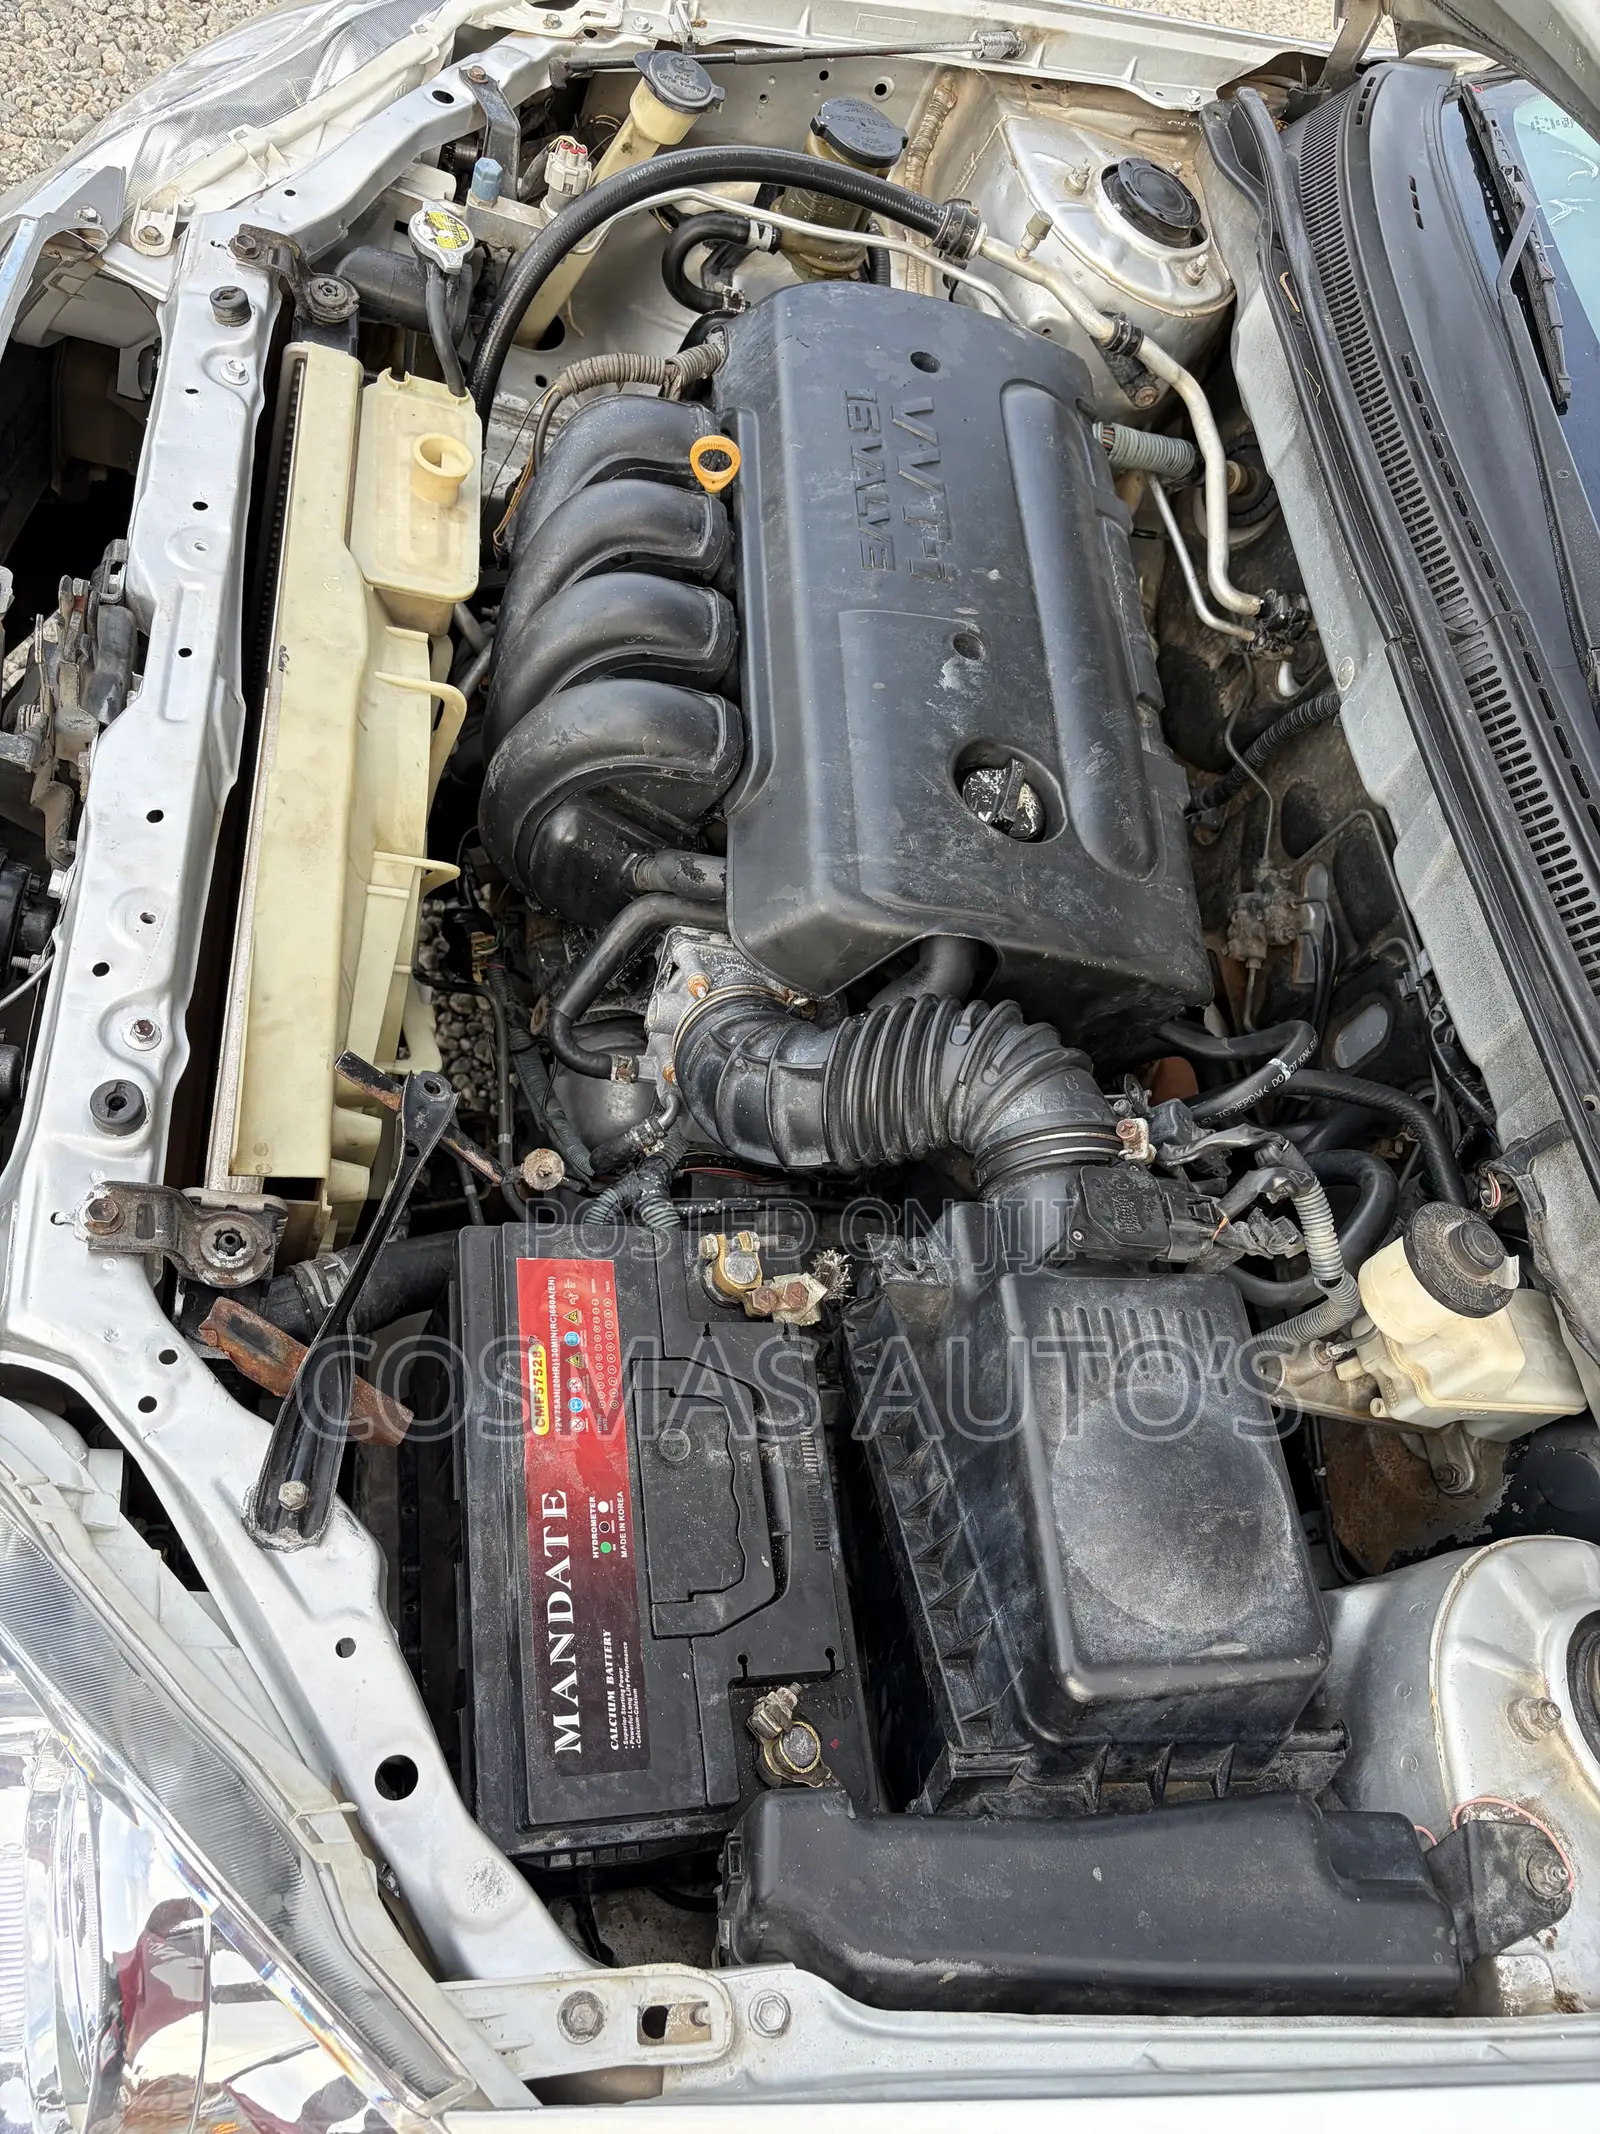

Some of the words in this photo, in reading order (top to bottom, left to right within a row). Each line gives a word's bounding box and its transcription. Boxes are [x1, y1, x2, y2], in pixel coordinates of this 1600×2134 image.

[1271, 1074, 1285, 1088] DO
[532, 1350, 546, 1428] CMF57528
[589, 1496, 600, 1559] HYDROMETER
[617, 1491, 625, 1521] KOREA
[619, 1522, 626, 1531] IN
[620, 1532, 628, 1558] MADE
[541, 1489, 582, 1754] MANDATE
[602, 1629, 615, 1685] BATTERY
[622, 1641, 631, 1683] Performance
[606, 1690, 619, 1750] CALCIUM
[622, 1715, 630, 1746] Superior
[632, 1688, 642, 1744] Calcium-Calcium
